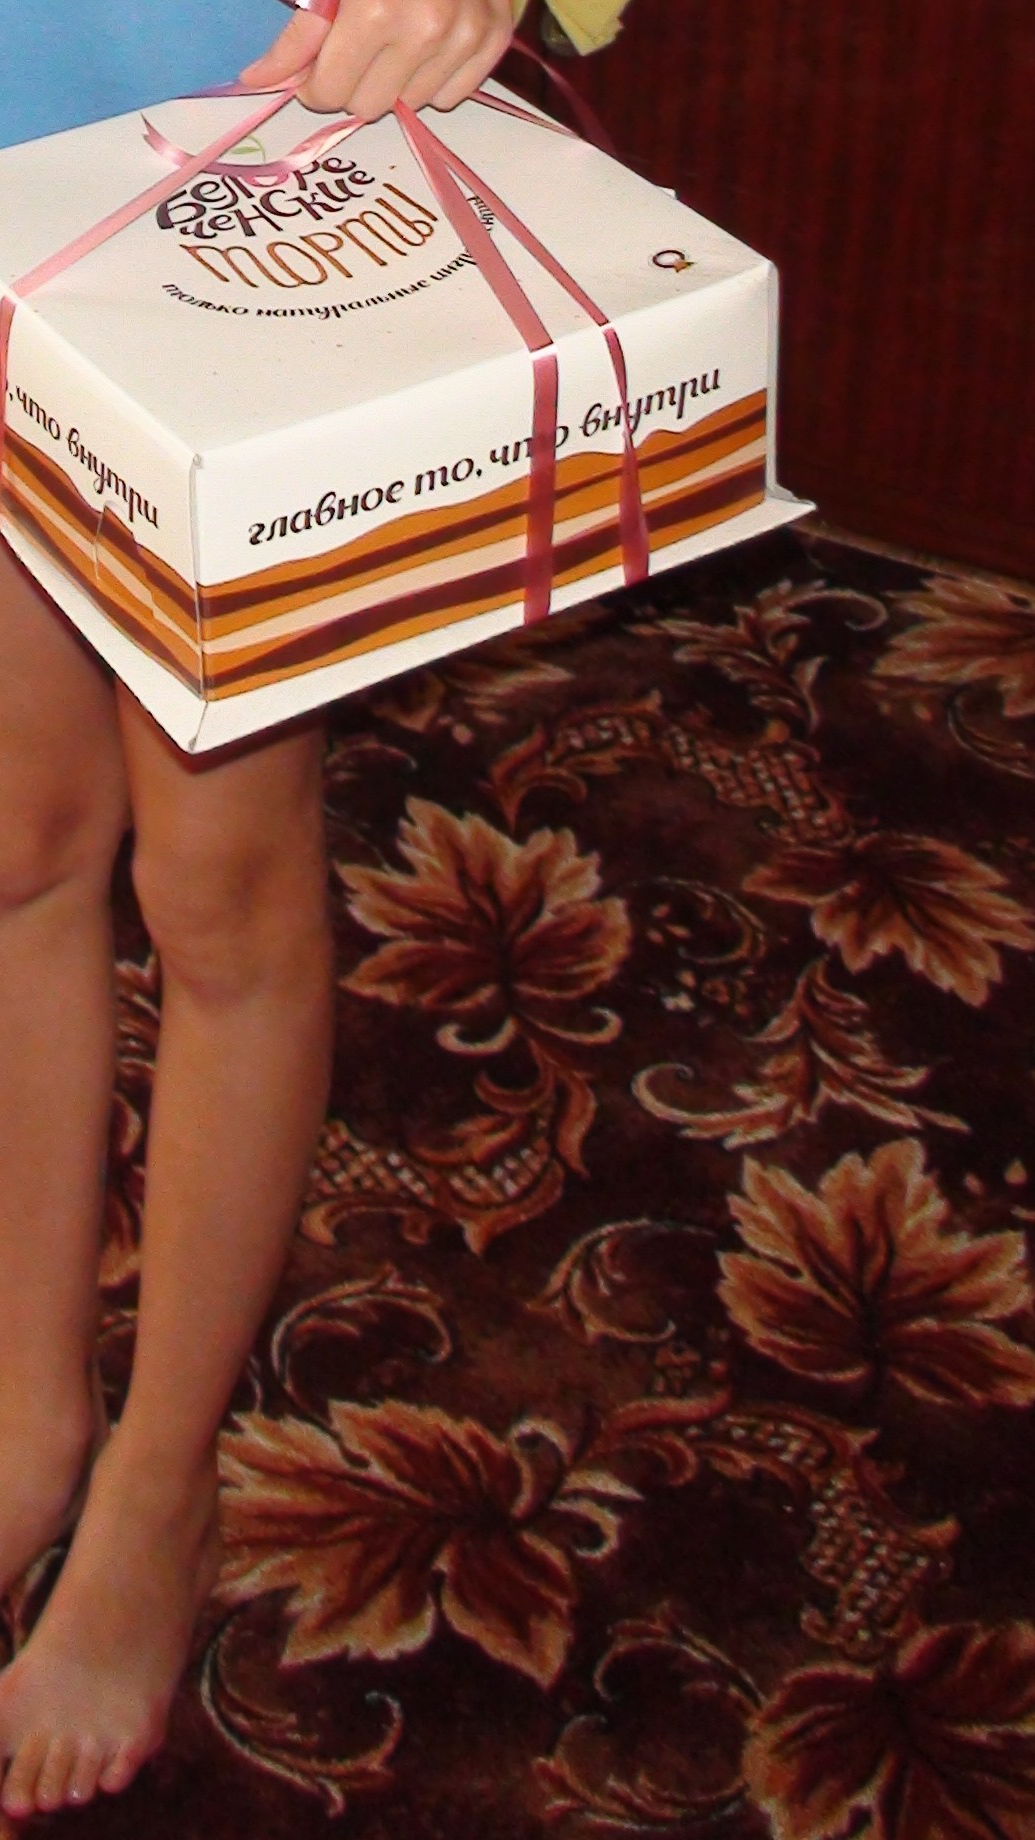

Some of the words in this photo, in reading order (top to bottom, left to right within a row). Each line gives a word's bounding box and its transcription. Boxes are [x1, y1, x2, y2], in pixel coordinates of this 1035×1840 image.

[162, 283, 250, 316] только
[257, 277, 429, 320] натуральные
[16, 385, 61, 440] что
[66, 427, 160, 529] внутри
[247, 481, 405, 546] главное
[413, 457, 483, 497] то,
[579, 367, 721, 437] внутри
